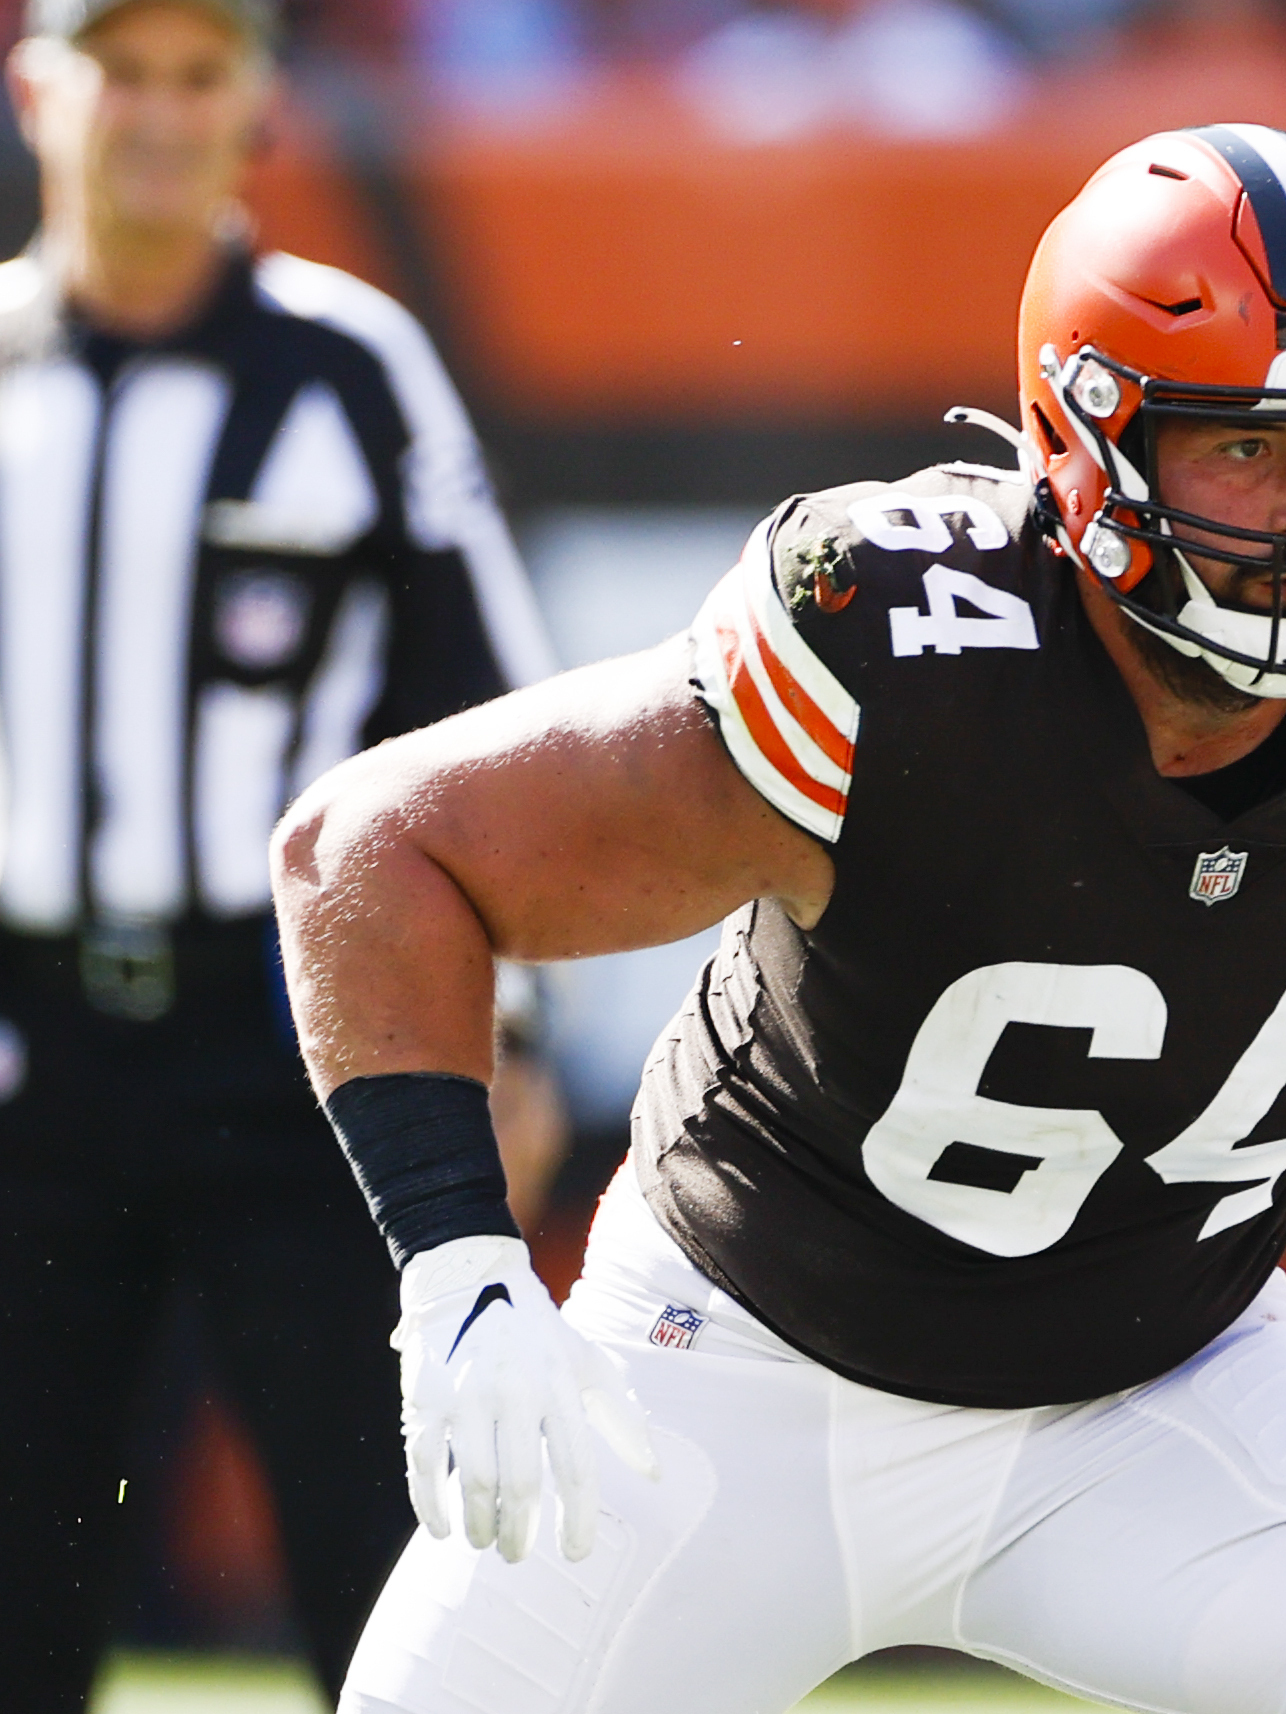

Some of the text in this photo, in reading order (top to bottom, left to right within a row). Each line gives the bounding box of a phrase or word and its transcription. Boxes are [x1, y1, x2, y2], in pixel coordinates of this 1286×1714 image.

[846, 492, 1040, 657] 64
[1198, 875, 1232, 896] NFL
[653, 1320, 687, 1350] NFL
